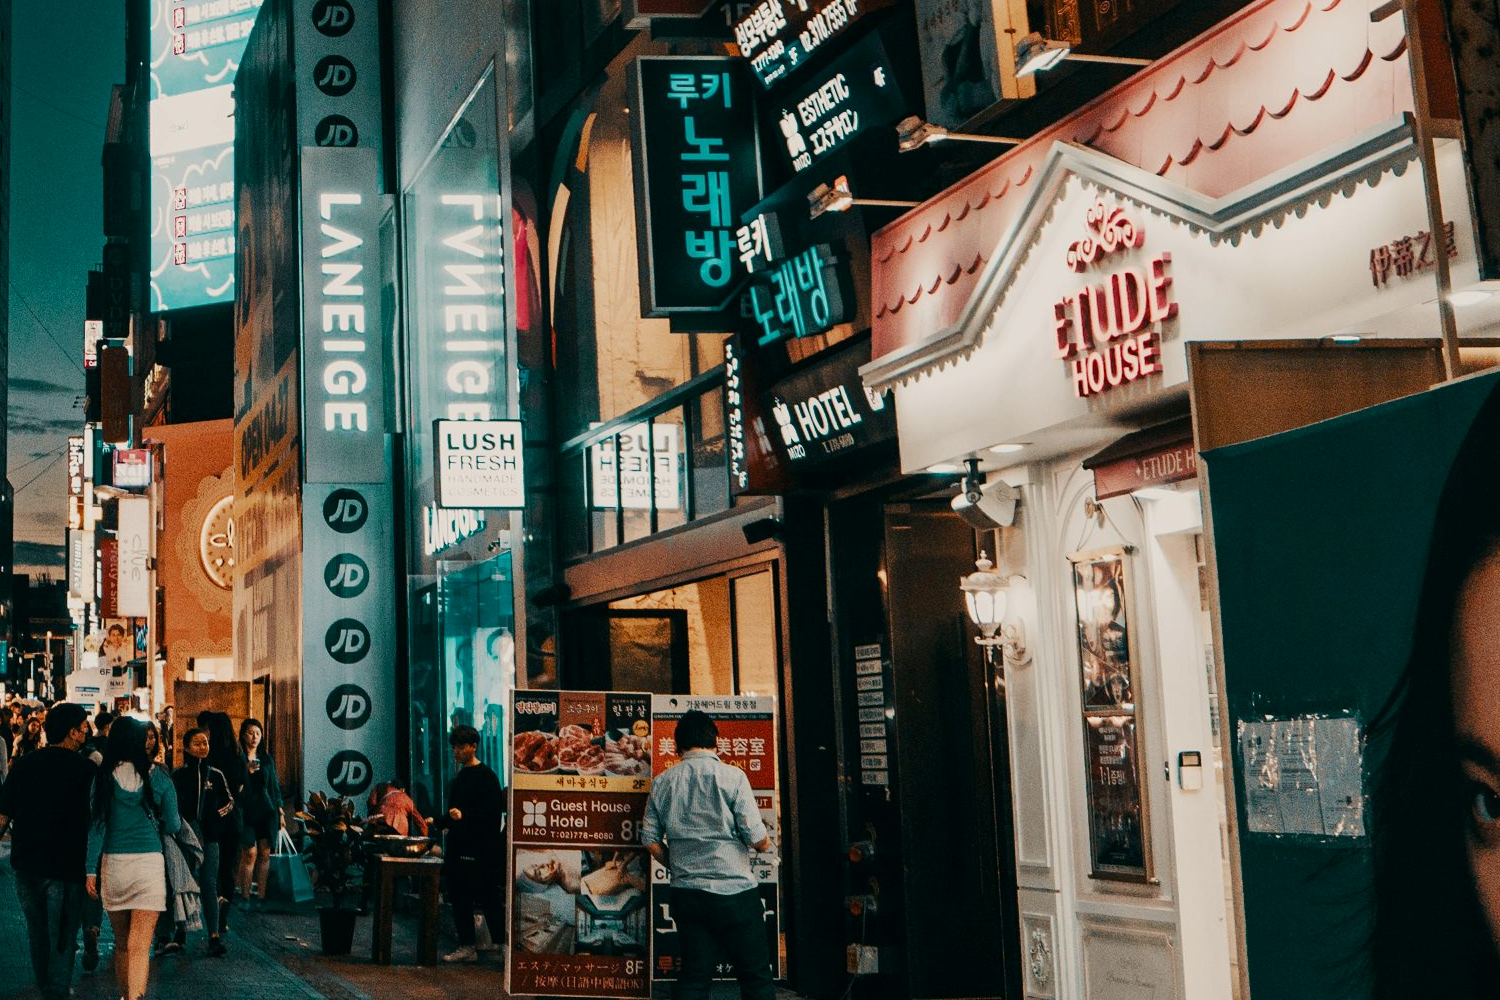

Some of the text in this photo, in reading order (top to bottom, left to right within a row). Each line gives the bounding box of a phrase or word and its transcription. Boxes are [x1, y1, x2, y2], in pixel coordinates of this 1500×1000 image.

[667, 74, 732, 109] 루키
[800, 73, 850, 128] ESTHETIC
[680, 117, 736, 287] 노래방
[750, 246, 831, 347] 노래방
[1055, 252, 1179, 360] ETUDE
[320, 193, 368, 432] LANEIGE
[1071, 332, 1163, 398] HOUSE
[794, 385, 862, 441] HOTEL
[447, 434, 515, 450] LUSH
[448, 455, 516, 470] FRESH
[1142, 449, 1184, 481] ETUDE
[448, 474, 516, 484] HANDMADE
[556, 777, 645, 790] 새마을식당 2F
[551, 799, 632, 813] Guest House
[522, 827, 547, 837] MIZO
[551, 815, 588, 828] Hotel
[760, 867, 773, 879] 3F
[625, 960, 645, 976] 8F
